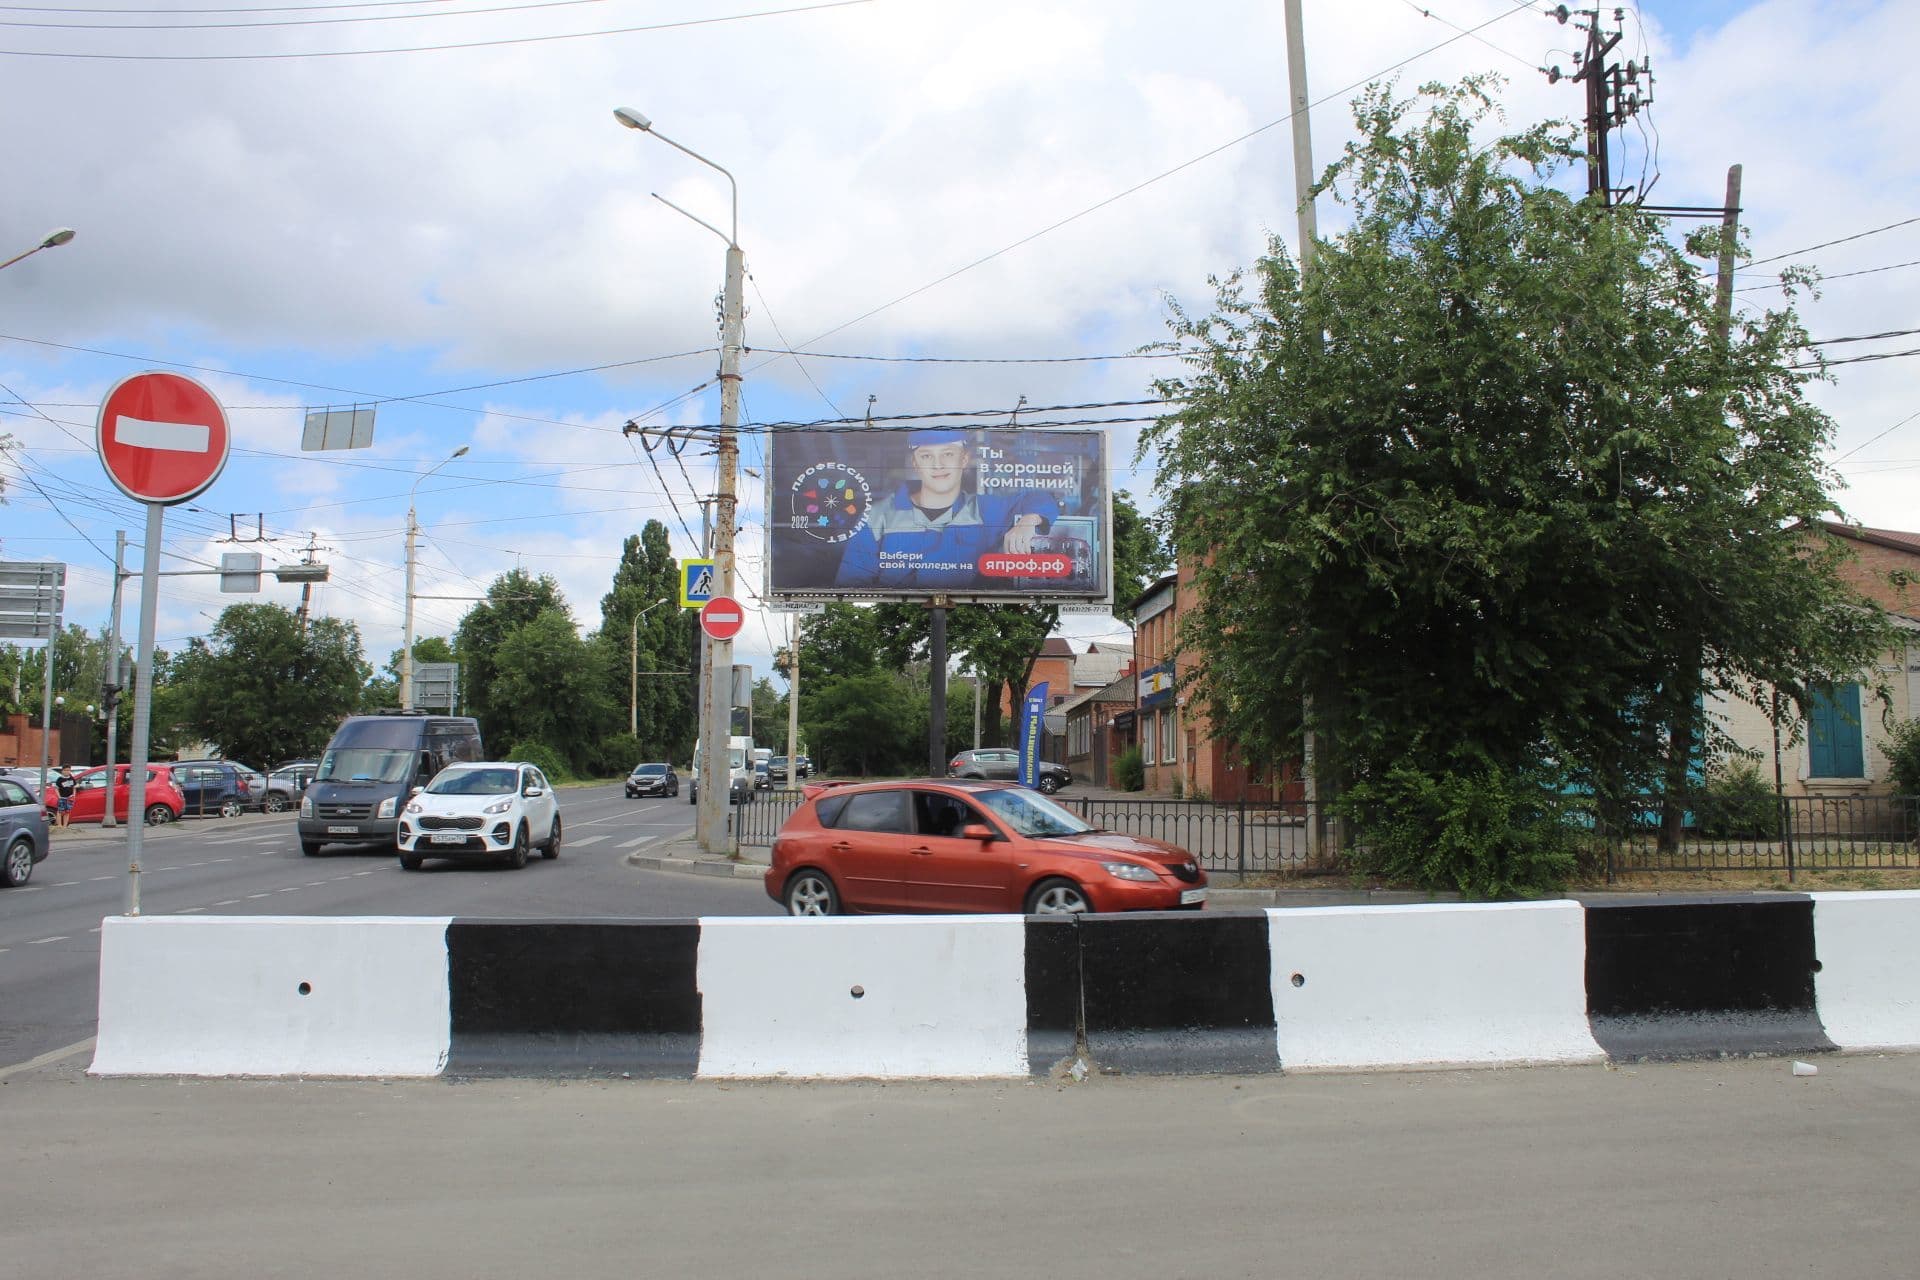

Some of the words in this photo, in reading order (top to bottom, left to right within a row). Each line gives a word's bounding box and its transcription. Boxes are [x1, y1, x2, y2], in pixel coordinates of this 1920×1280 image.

[979, 446, 1004, 459] Ты
[980, 463, 989, 473] в
[994, 462, 1074, 476] хорошей
[980, 477, 1074, 489] компании!
[792, 462, 873, 543] ПРОФЕССИОНАЛИТЕТ
[791, 516, 809, 529] 2022
[879, 551, 924, 562] Выбери
[879, 560, 906, 569] свой
[908, 561, 958, 571] колледж
[960, 562, 974, 571] на
[986, 558, 1065, 573] япроф.рф
